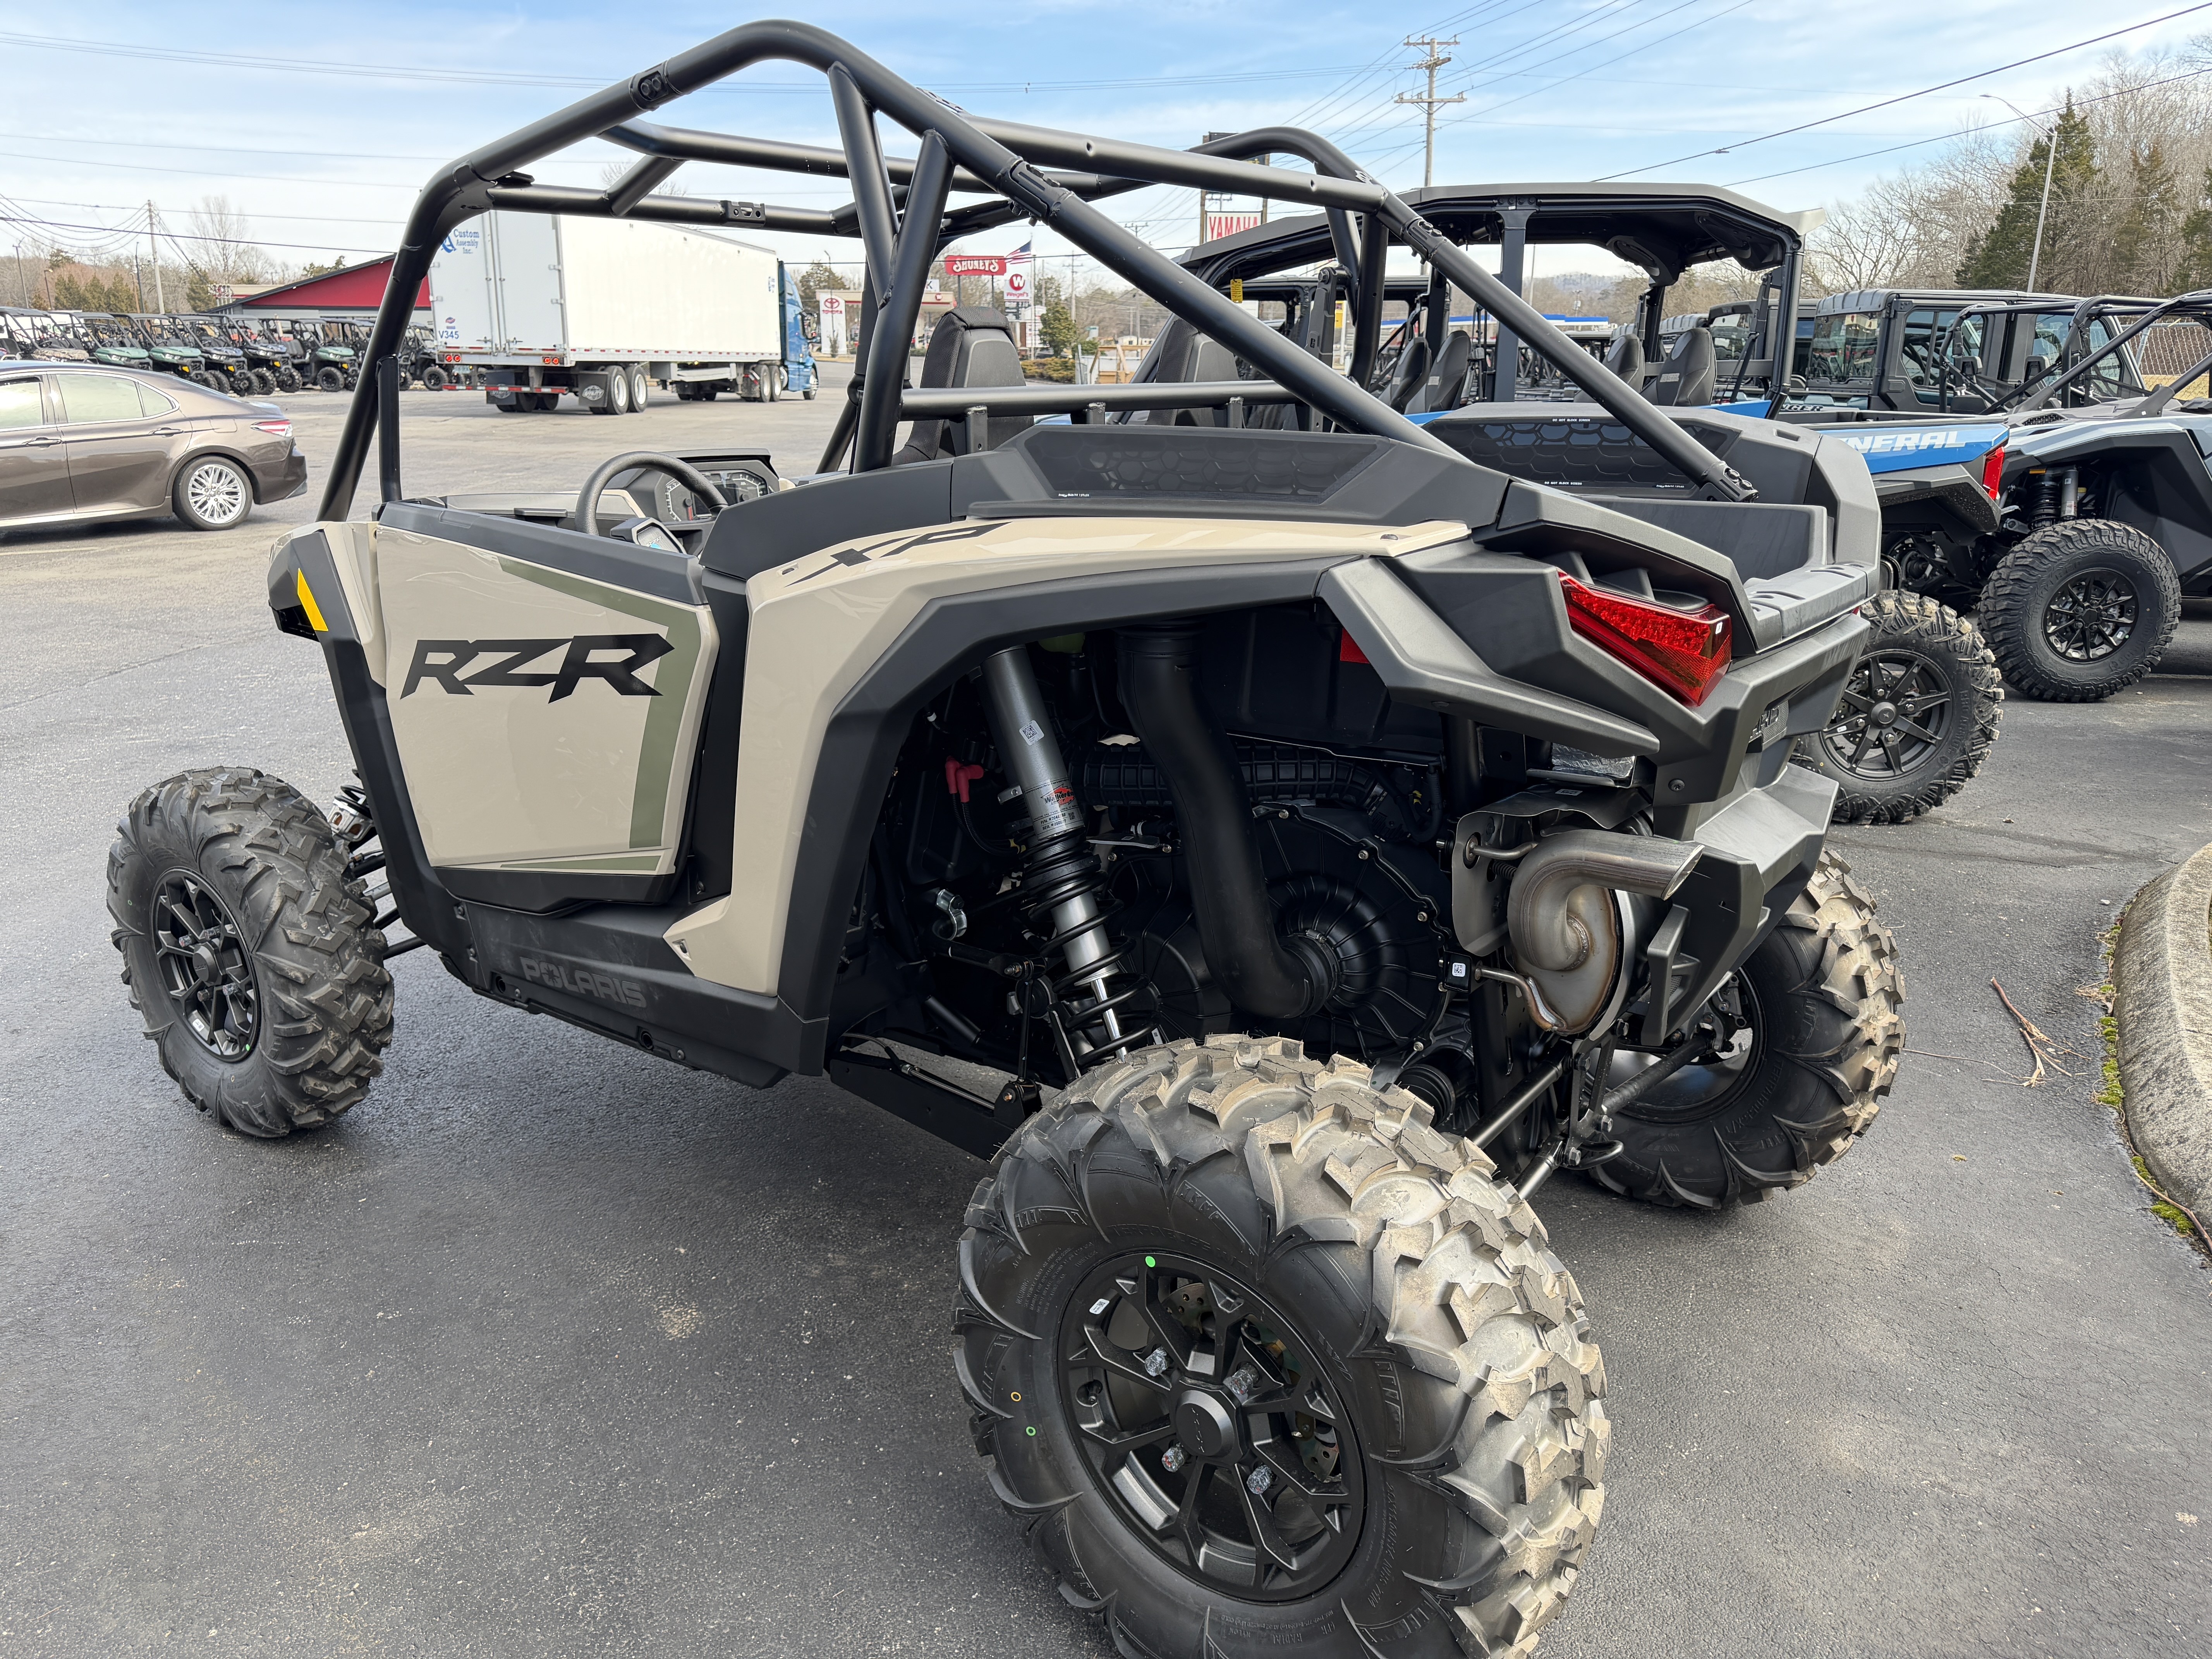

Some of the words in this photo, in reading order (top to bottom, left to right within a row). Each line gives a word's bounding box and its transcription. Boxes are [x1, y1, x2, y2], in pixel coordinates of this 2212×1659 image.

[453, 229, 479, 238] Custom
[456, 239, 478, 248] Assembly
[1013, 276, 1025, 287] W
[438, 330, 459, 339] V345
[1840, 431, 1966, 453] NERAL
[784, 522, 1013, 587] XP
[400, 633, 675, 704] RZR
[520, 956, 647, 1008] POLARIS
[1074, 1250, 1098, 1267] TUBELESS
[1042, 1279, 1054, 1296] INFLATE
[1051, 1264, 1064, 1279] BEYOND
[1015, 1278, 1030, 1305] WARNING:
[1029, 1293, 1039, 1310] MANUAL
[1228, 1626, 1251, 1638] NYLON
